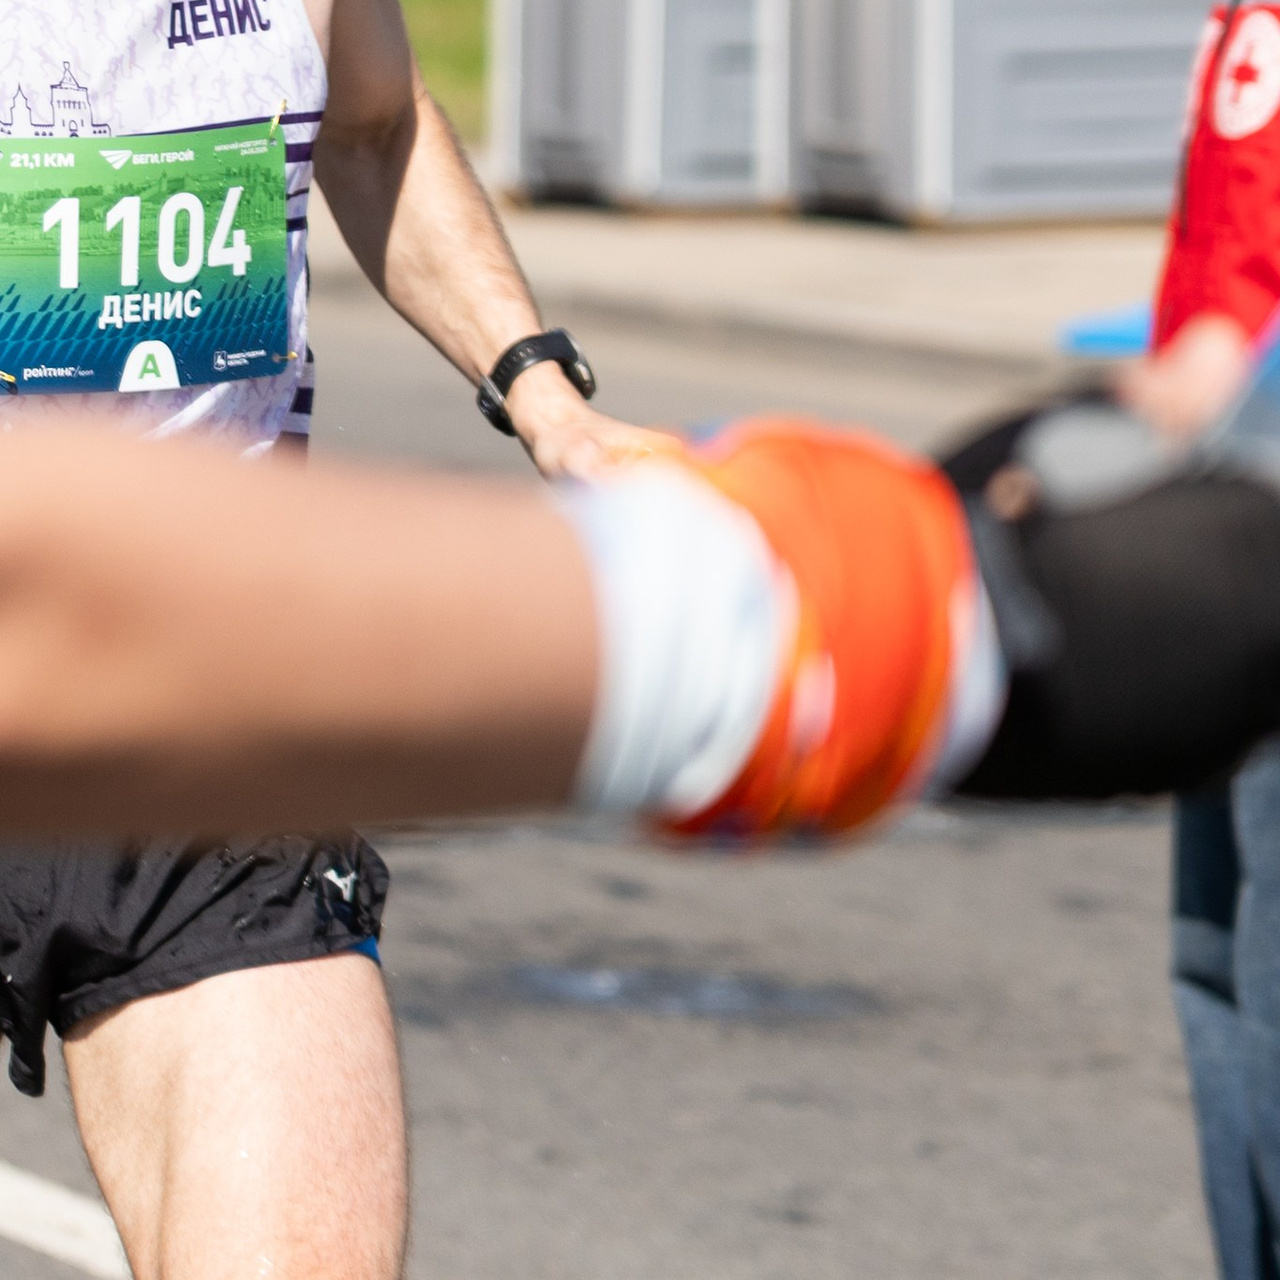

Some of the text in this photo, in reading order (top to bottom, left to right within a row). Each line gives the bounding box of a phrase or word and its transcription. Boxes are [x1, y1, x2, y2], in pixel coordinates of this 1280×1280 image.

[10, 152, 40, 169] 21,1
[42, 186, 252, 289] 1104
[98, 289, 202, 329] ДЕНИС
